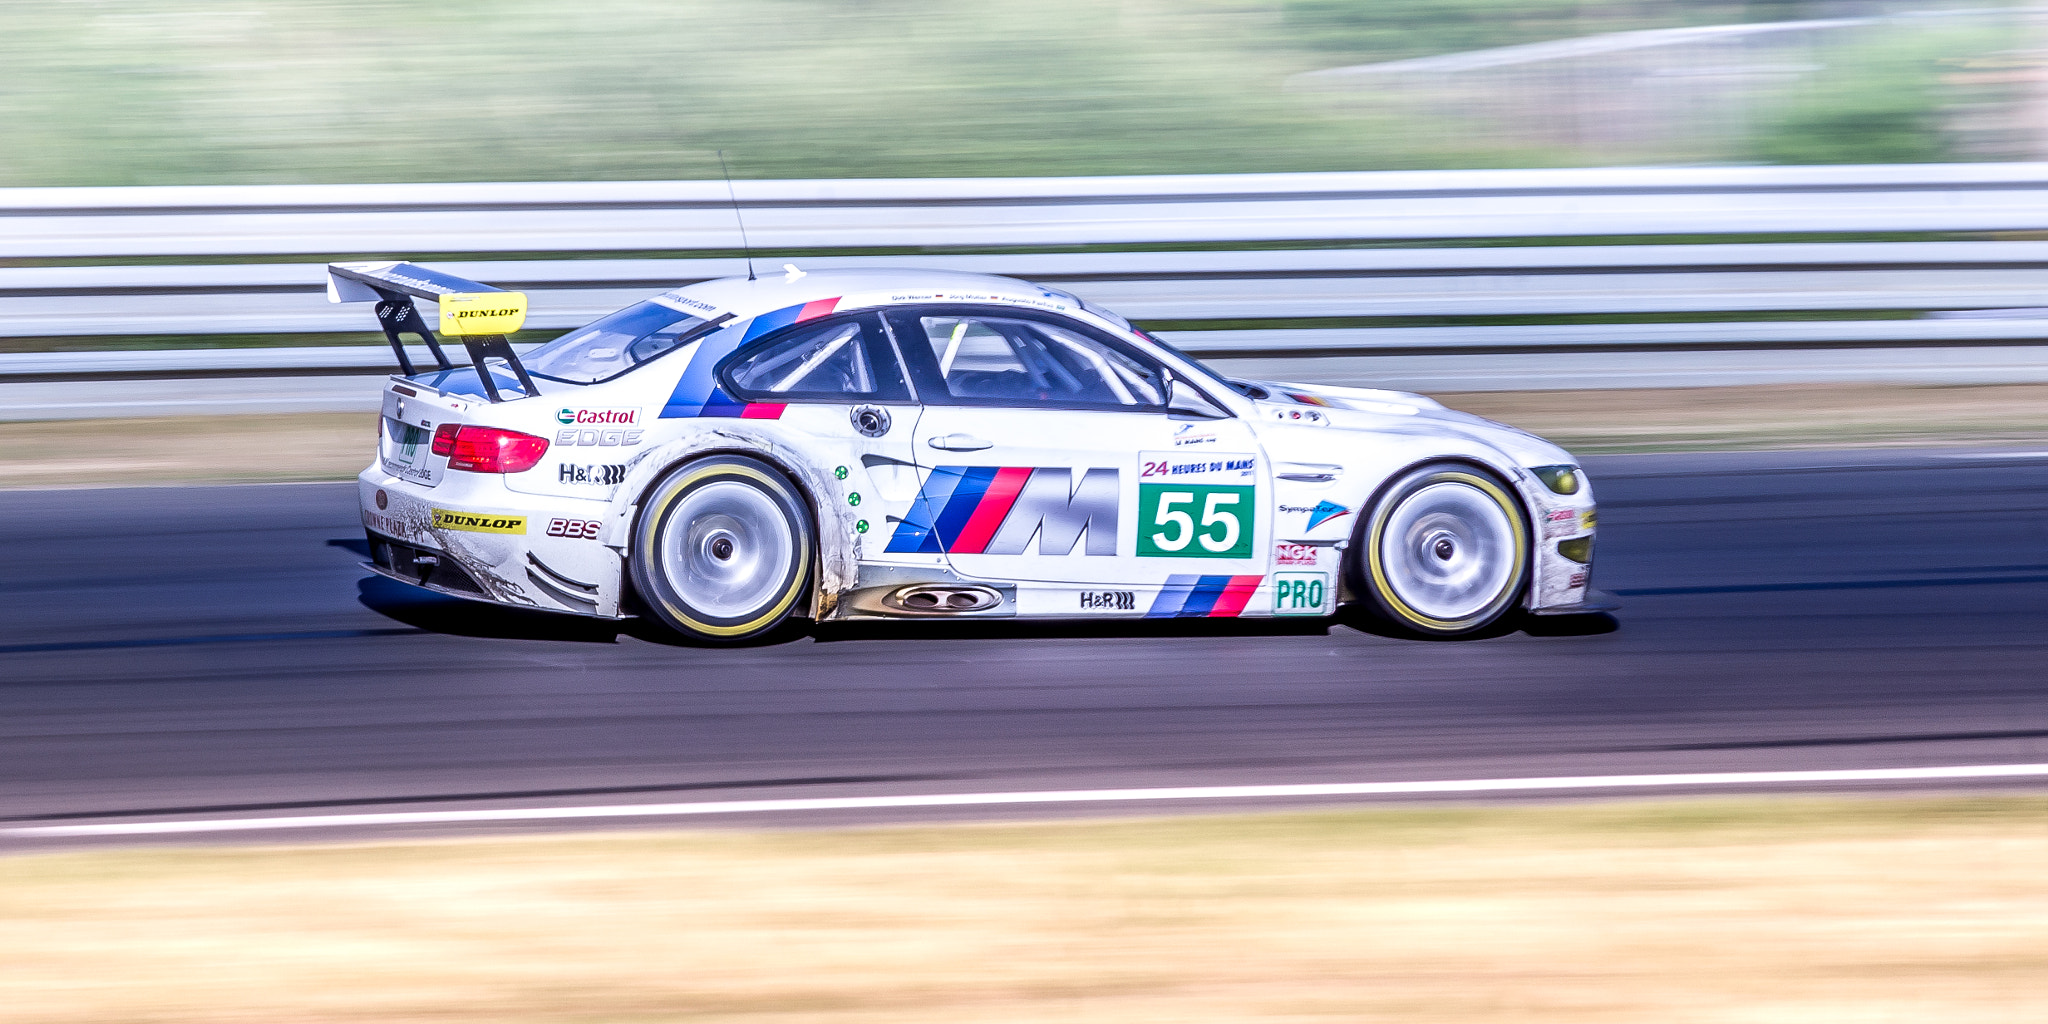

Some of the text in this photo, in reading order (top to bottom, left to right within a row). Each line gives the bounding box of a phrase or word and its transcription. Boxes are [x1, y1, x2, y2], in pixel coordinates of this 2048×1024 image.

[458, 308, 519, 319] DUNLOP
[576, 409, 635, 424] Castrol
[555, 429, 645, 447] EDGE
[1141, 459, 1255, 477] 24 HEURES DU MANS
[443, 514, 522, 529] DUNLOP
[546, 518, 602, 540] BBS
[1152, 491, 1240, 552] 55
[1277, 545, 1318, 560] NGK
[1277, 580, 1323, 608] PRO
